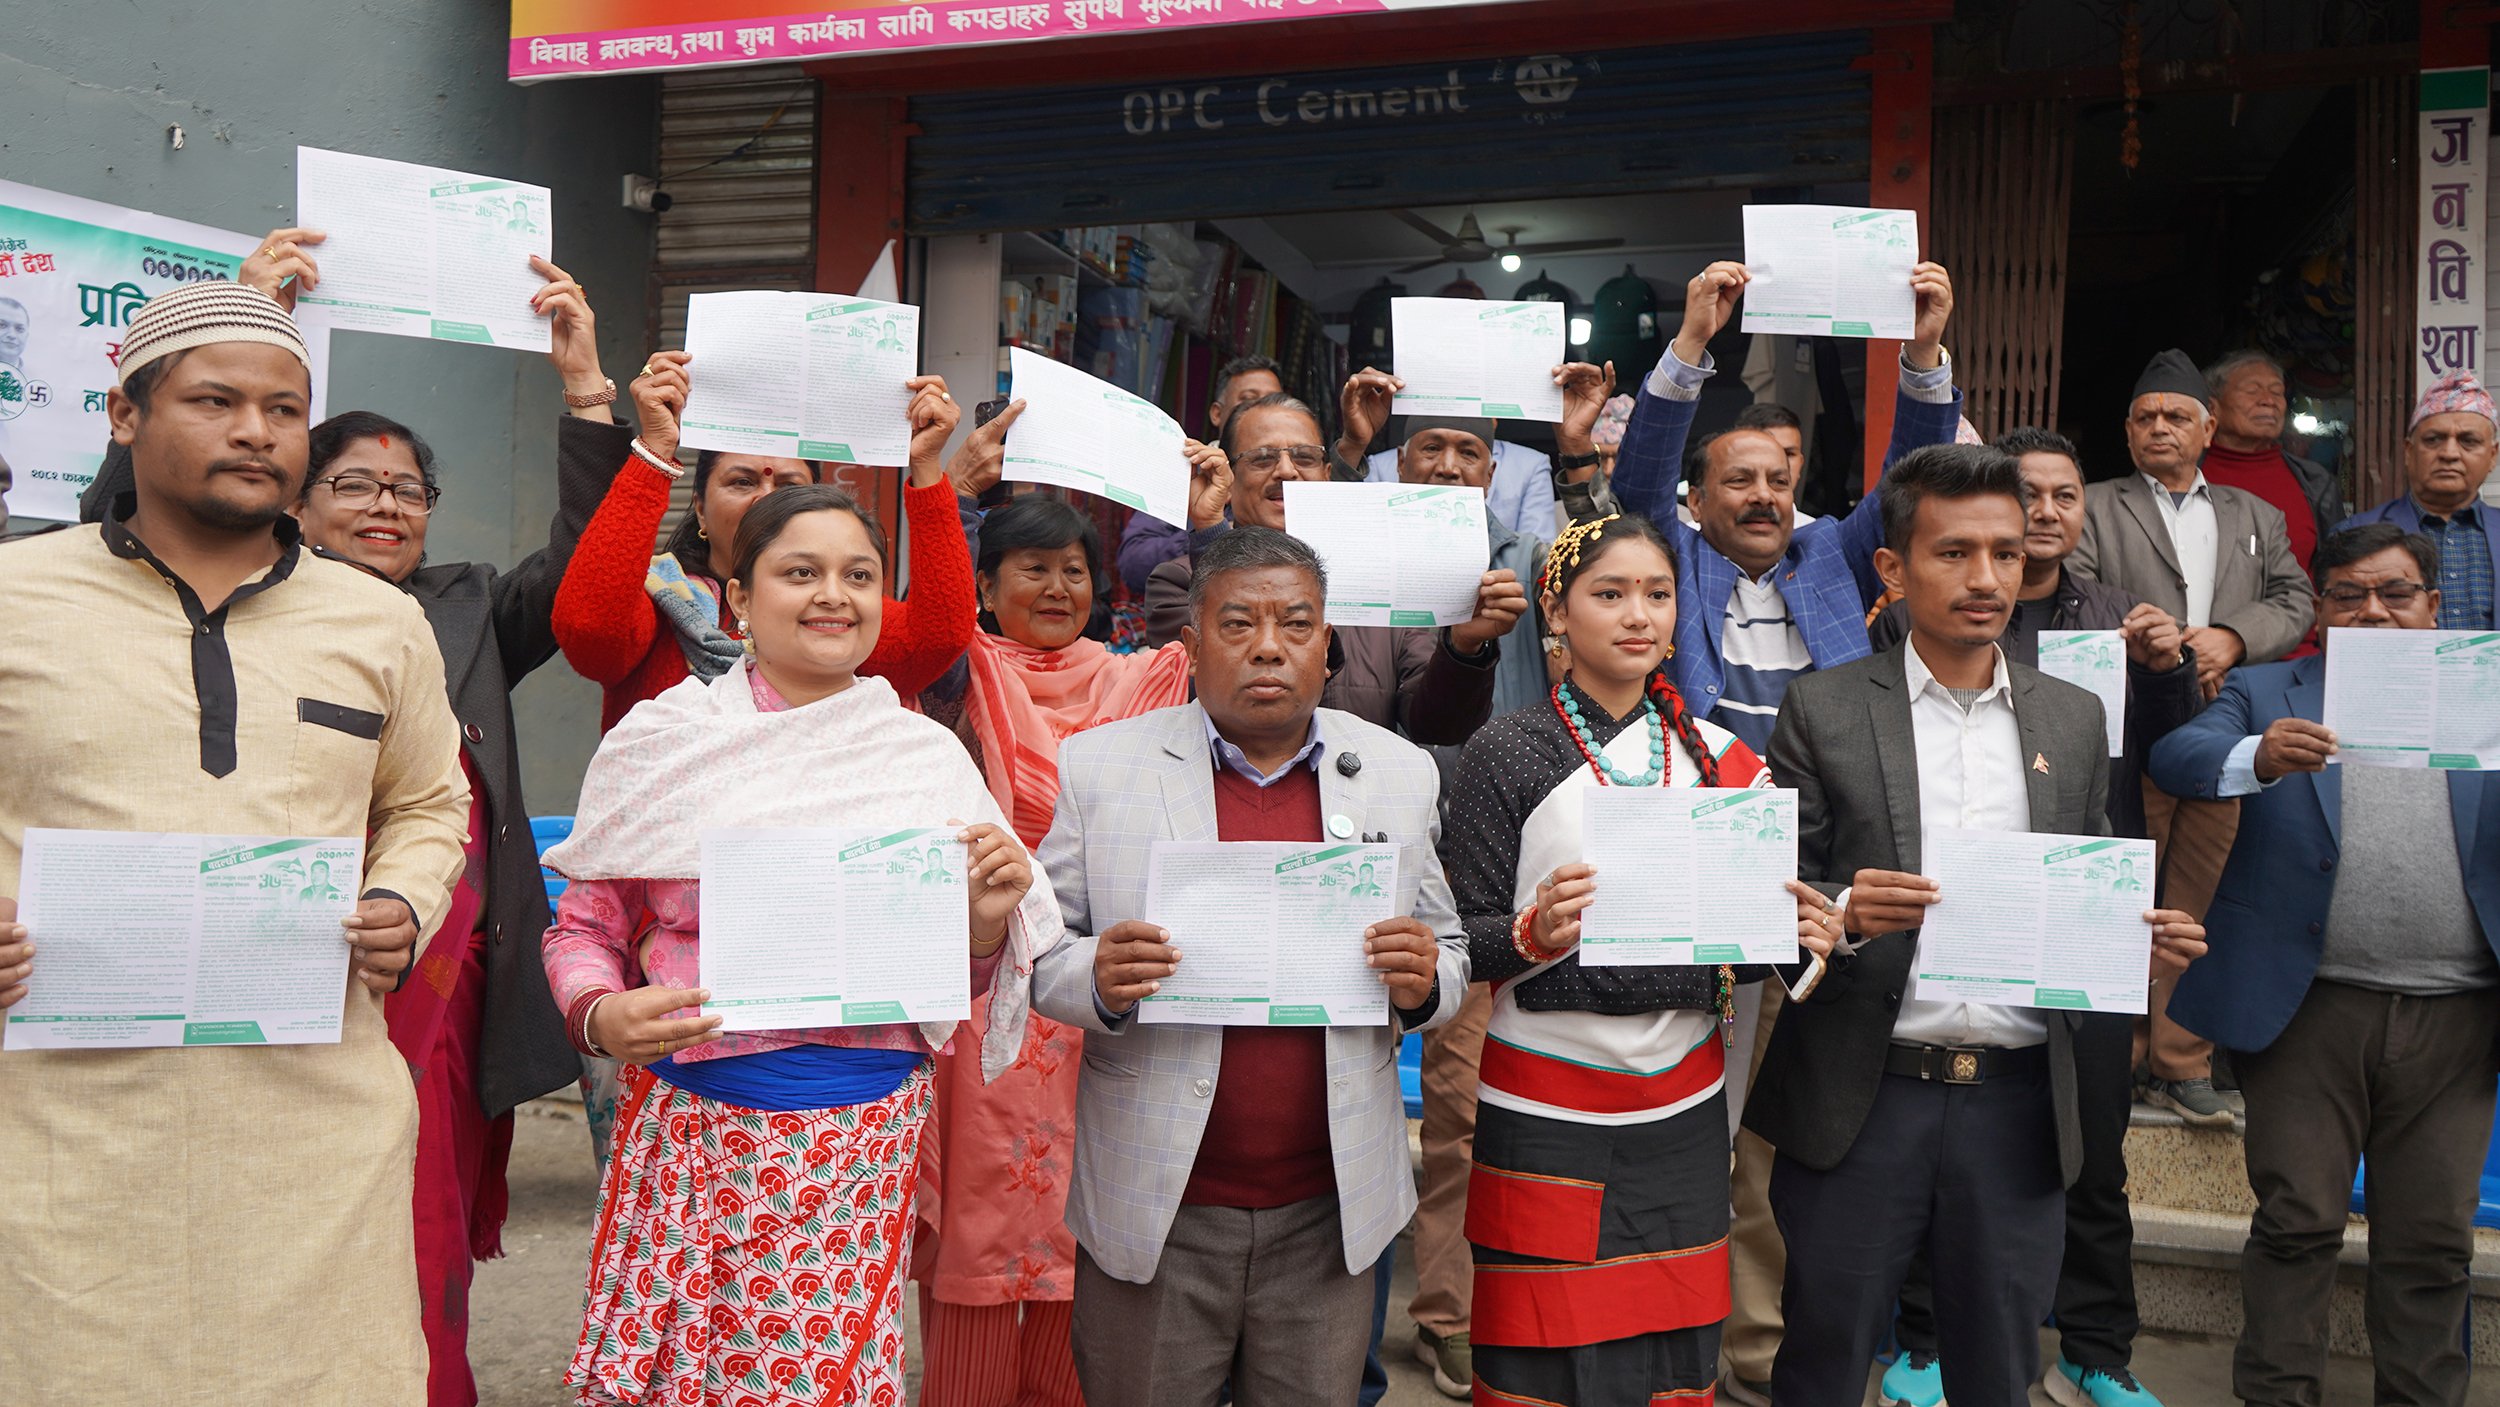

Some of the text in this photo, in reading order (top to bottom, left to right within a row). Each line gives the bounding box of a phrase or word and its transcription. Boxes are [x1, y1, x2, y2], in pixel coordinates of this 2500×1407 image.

[529, 38, 589, 65] विवाह
[736, 27, 774, 55] शुभ
[788, 15, 865, 44] कार्यका
[878, 6, 933, 38] लागि
[1064, 0, 1123, 29] सुपथ
[1122, 85, 1224, 137] OPC
[1257, 69, 1471, 126] Cement
[21, 251, 57, 275] देश
[31, 468, 59, 481] २०८२
